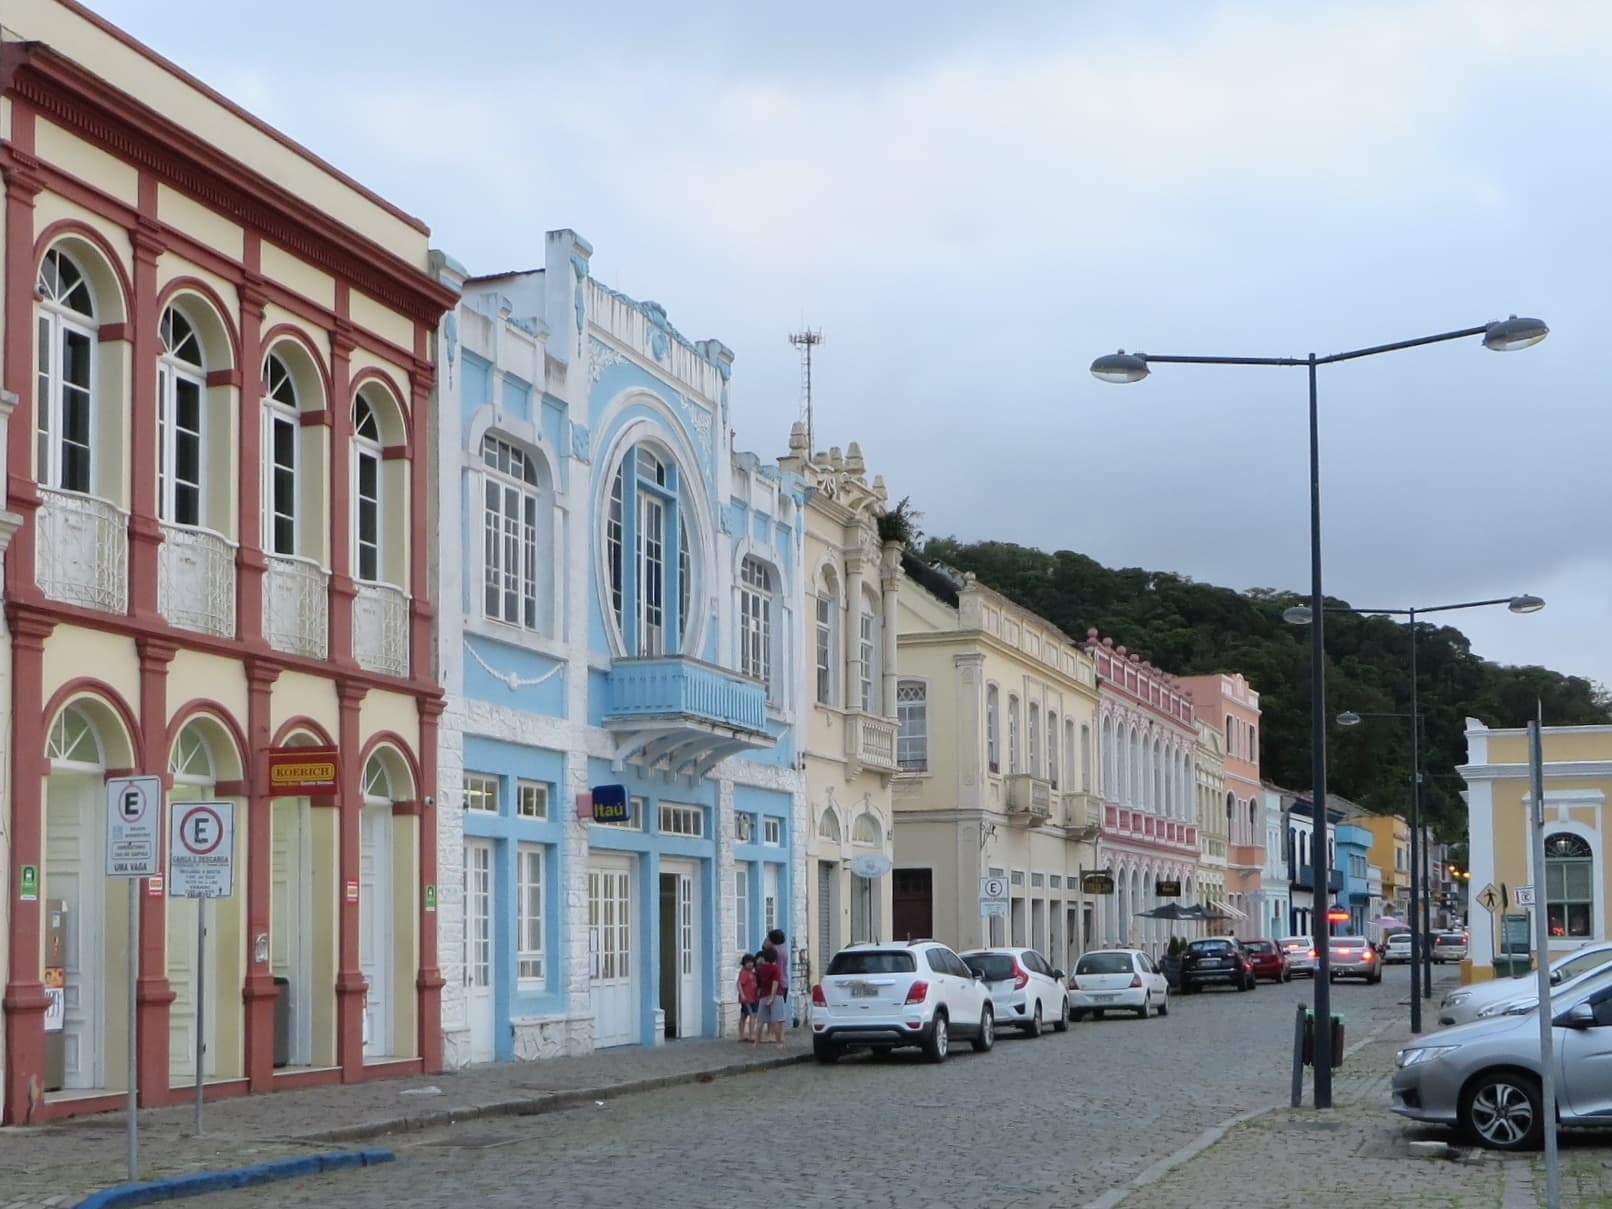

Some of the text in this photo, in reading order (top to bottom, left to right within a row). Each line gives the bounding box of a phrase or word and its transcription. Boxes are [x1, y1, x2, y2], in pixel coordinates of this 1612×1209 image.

[276, 767, 329, 777] KOERICH
[125, 792, 139, 815] E
[594, 802, 624, 818] Itaú
[194, 818, 209, 843] E
[130, 862, 147, 871] VAGA
[990, 882, 997, 893] E
